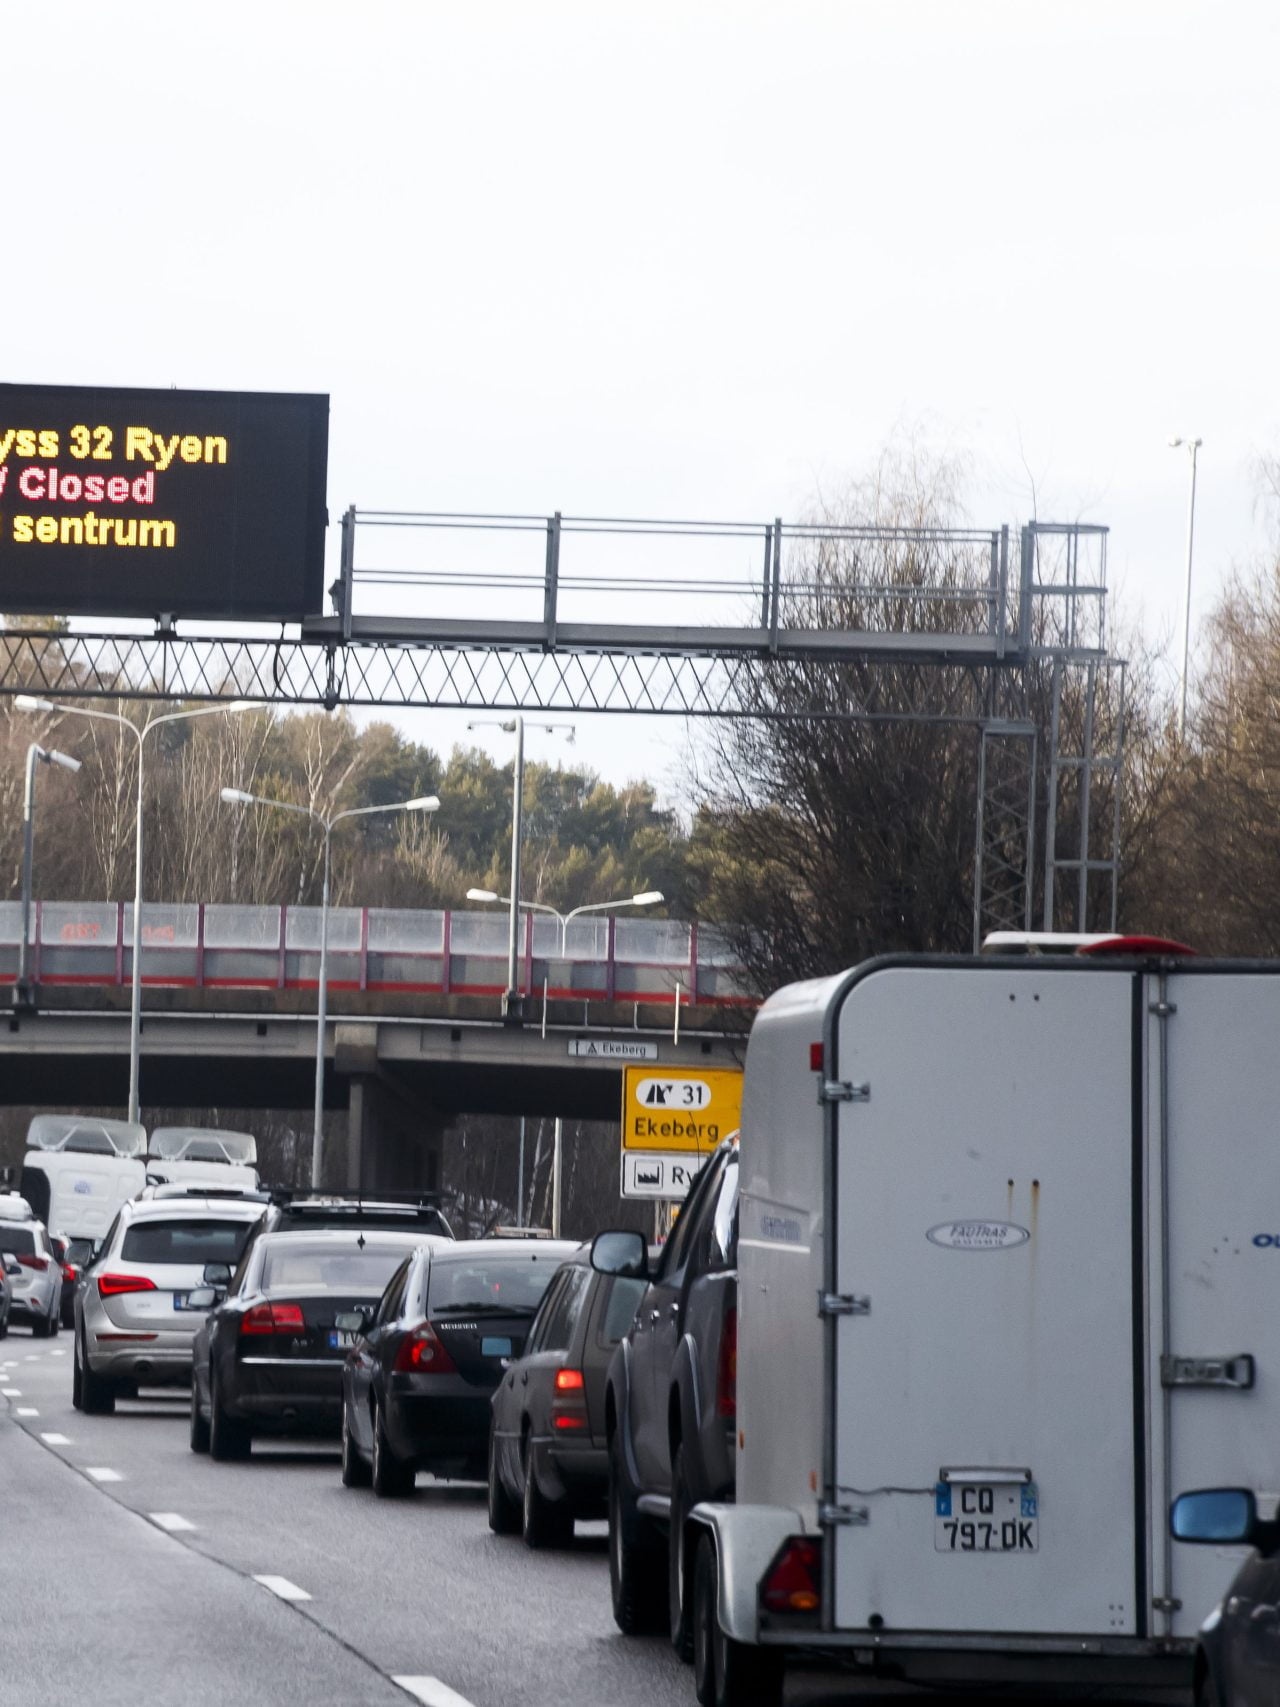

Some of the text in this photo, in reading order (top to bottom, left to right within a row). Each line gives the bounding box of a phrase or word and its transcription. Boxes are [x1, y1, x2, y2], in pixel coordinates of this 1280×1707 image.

[70, 425, 113, 460] 32
[126, 426, 227, 471] Ryen
[19, 466, 155, 504] Closed
[13, 511, 176, 548] sentrum
[602, 1042, 647, 1057] Ekeberg
[682, 1085, 703, 1105] 31
[634, 1117, 720, 1143] Ekeberg
